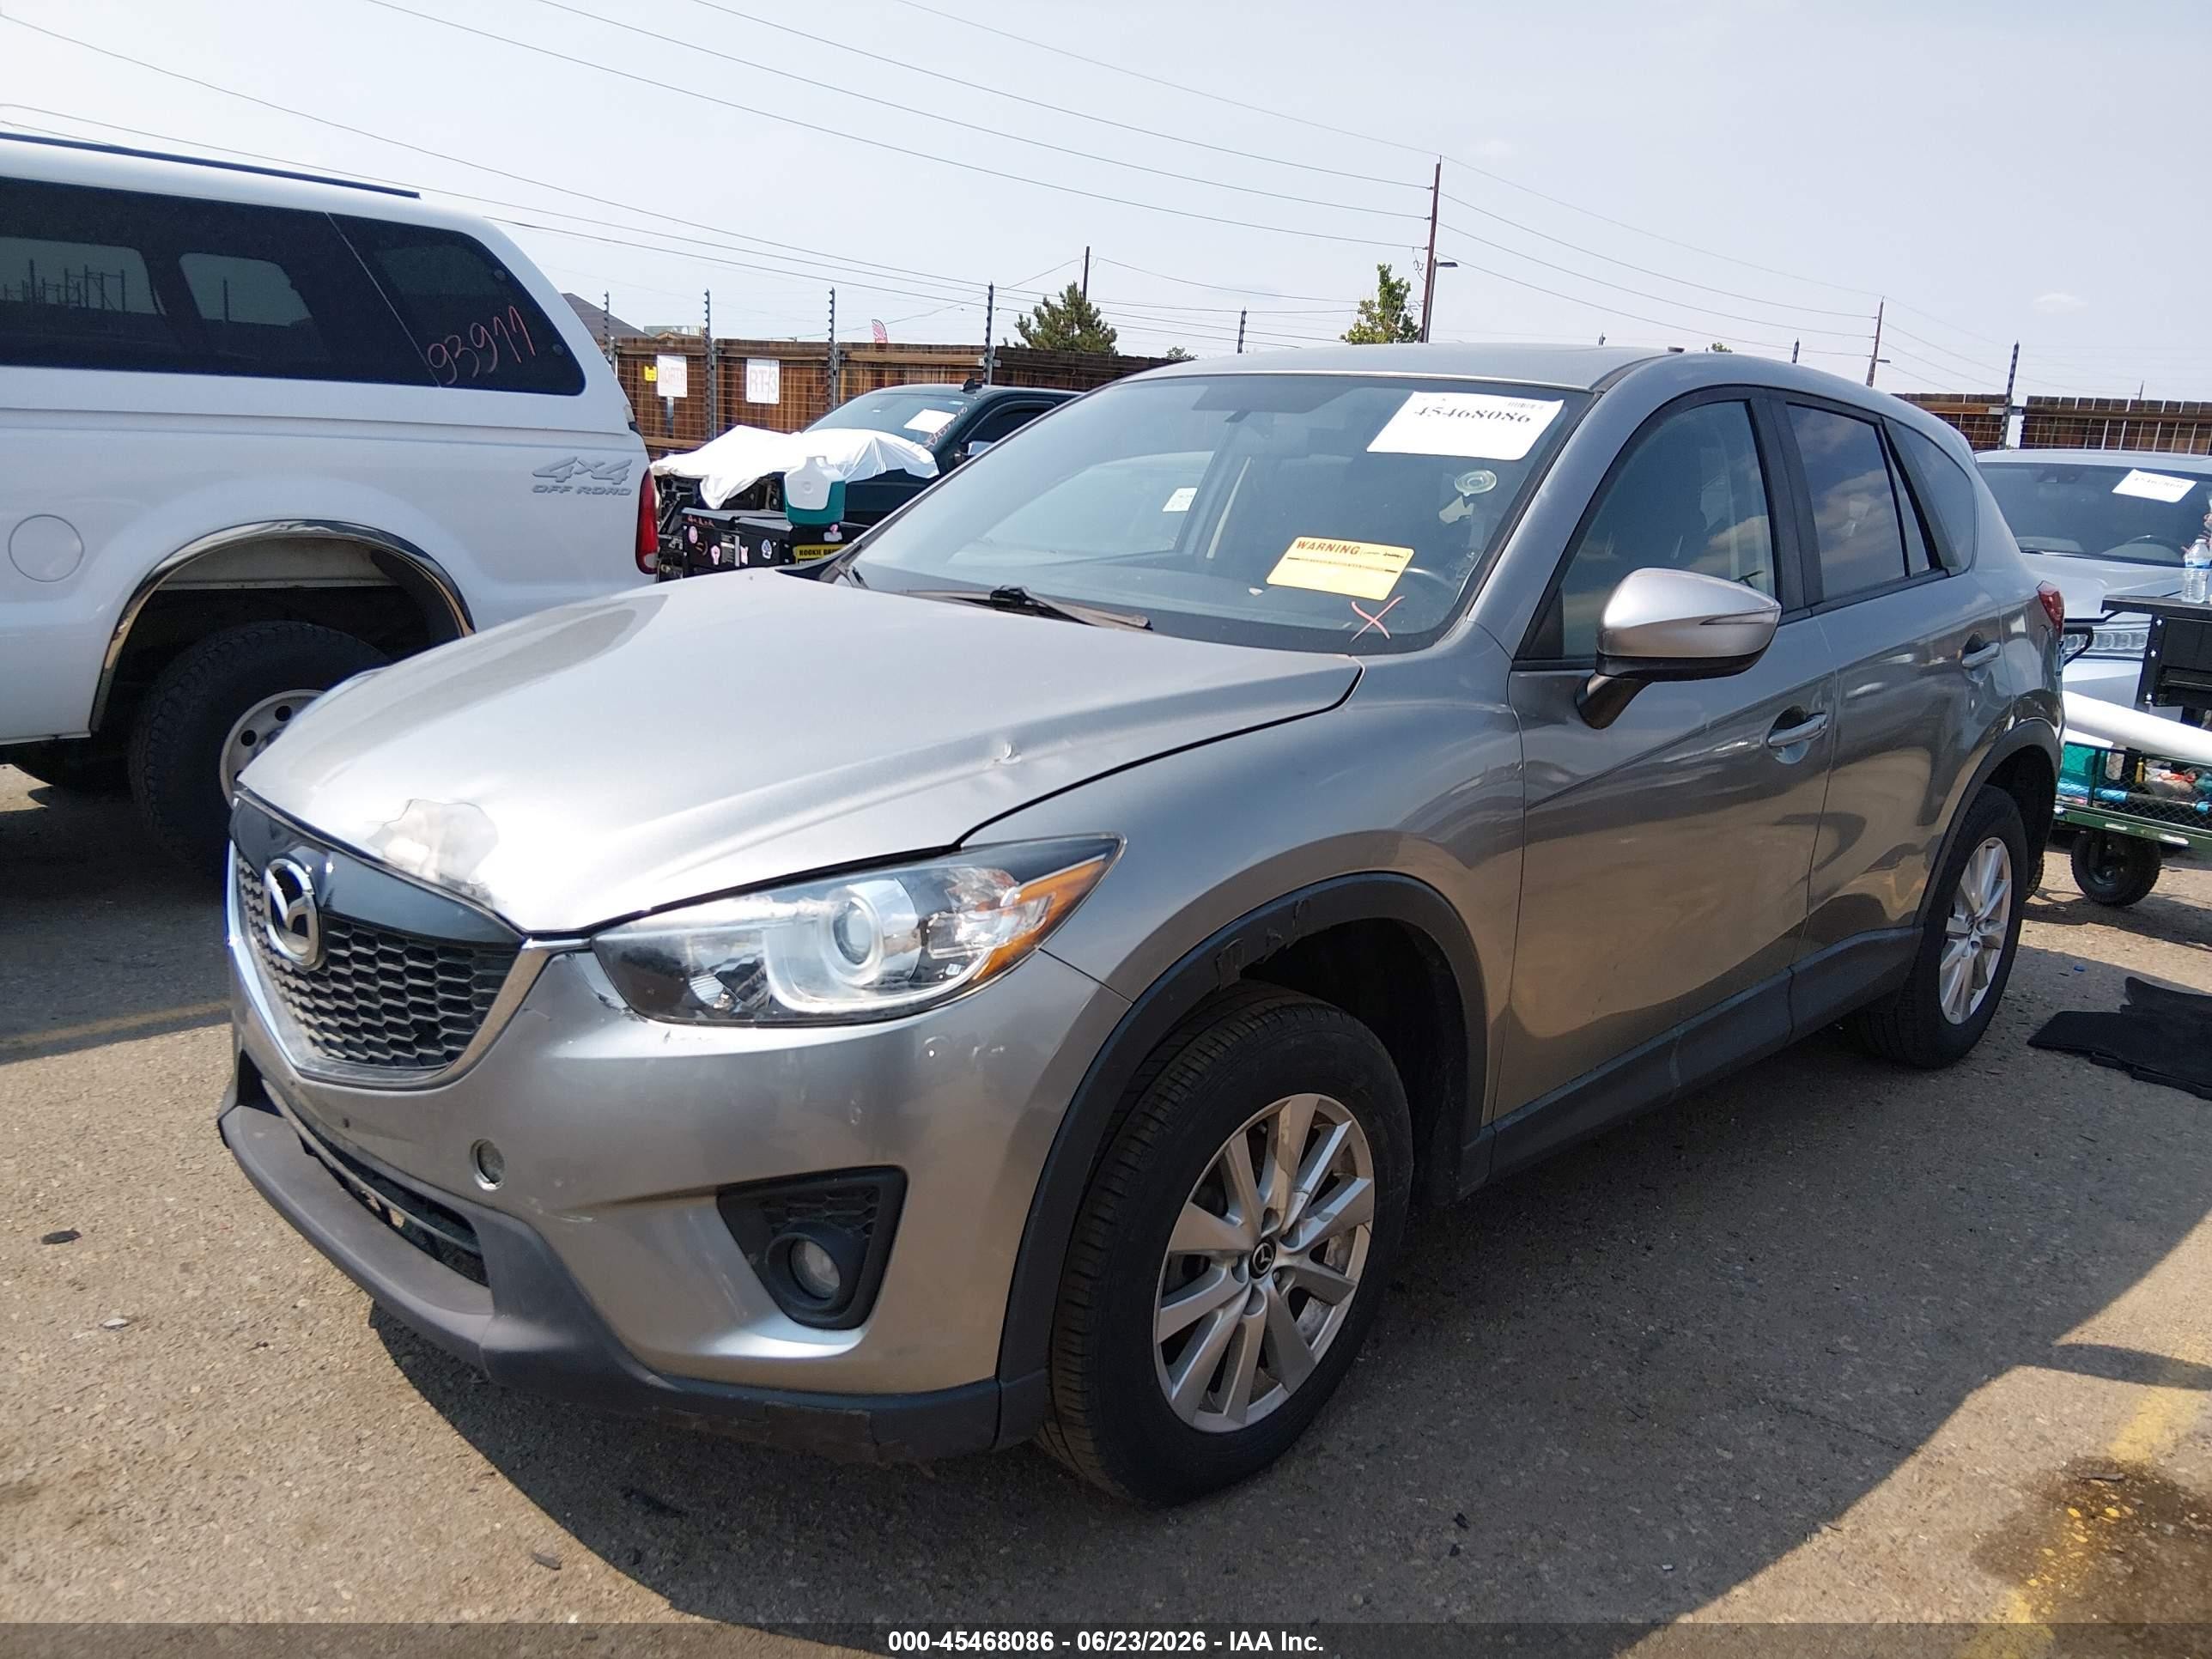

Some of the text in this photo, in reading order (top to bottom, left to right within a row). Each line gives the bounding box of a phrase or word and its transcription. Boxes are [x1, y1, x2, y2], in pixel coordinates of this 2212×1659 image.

[1414, 405, 1532, 423] 45468086
[532, 484, 633, 496] OFF ROAD
[1297, 540, 1361, 556] WARNING
